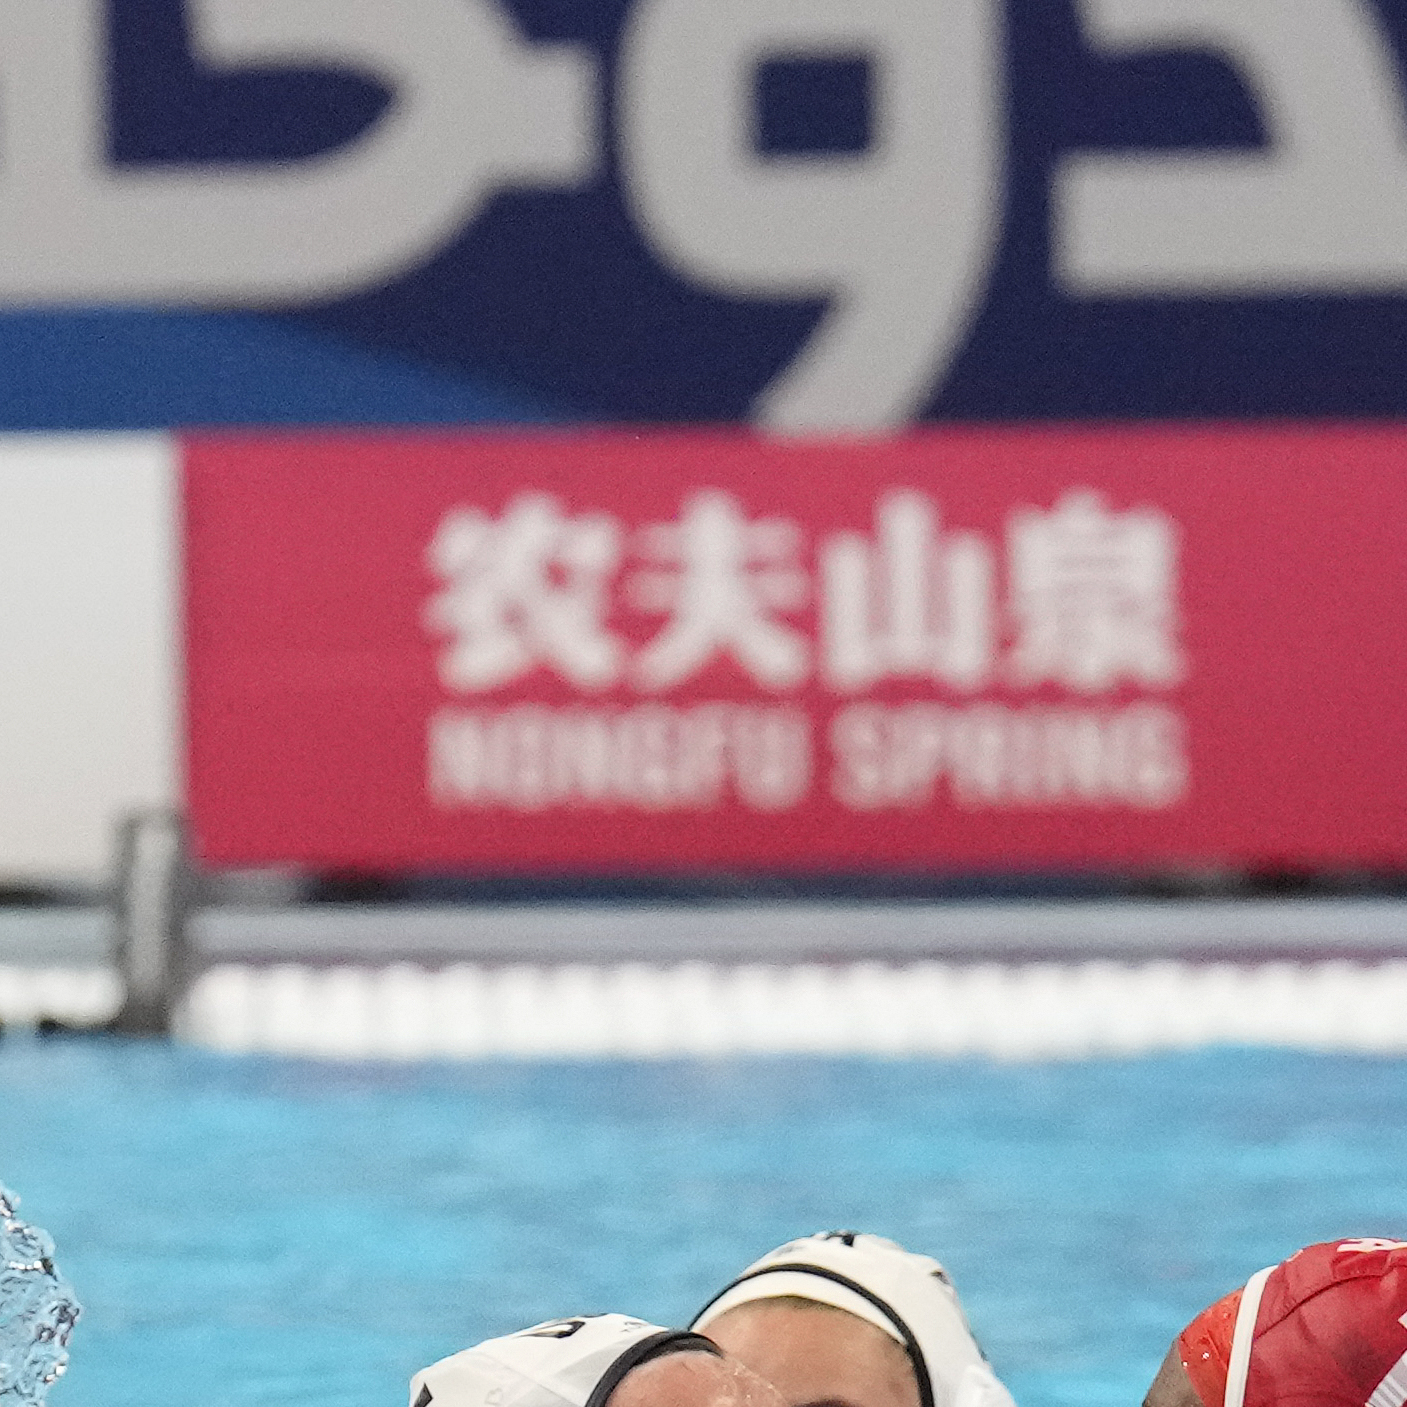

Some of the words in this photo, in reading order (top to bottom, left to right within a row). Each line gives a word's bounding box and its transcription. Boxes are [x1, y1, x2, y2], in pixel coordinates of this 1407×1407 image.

[424, 488, 1184, 694] 农夫山泉
[428, 703, 811, 808] NONGFU
[830, 703, 1186, 808] SPRING
